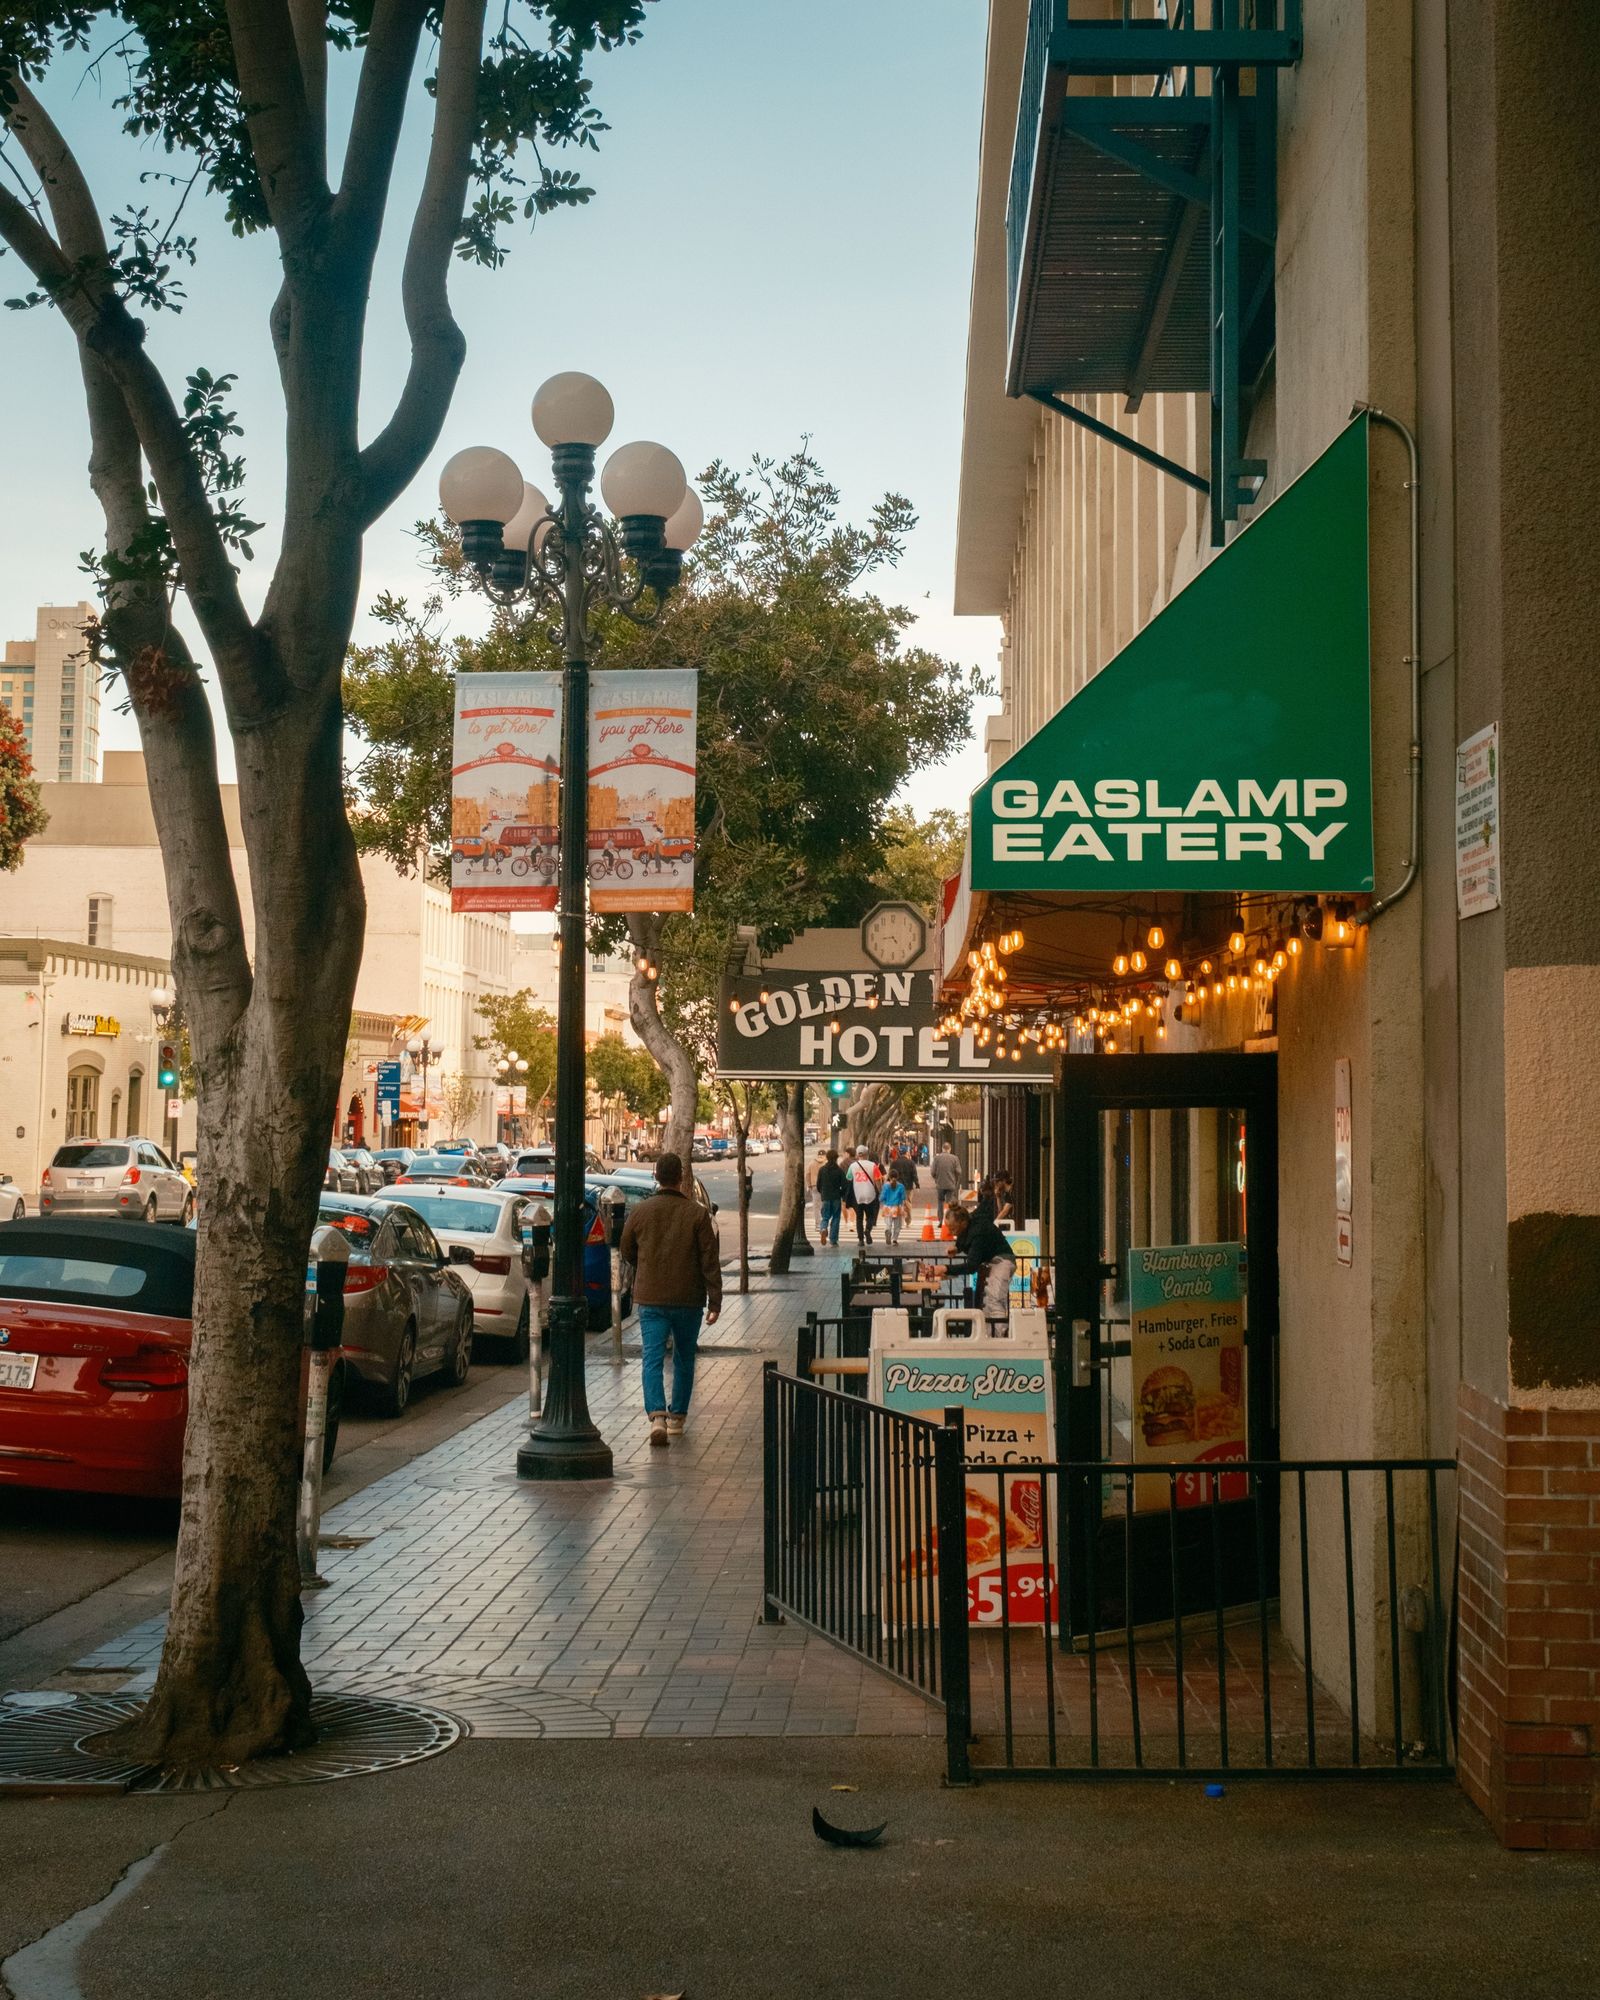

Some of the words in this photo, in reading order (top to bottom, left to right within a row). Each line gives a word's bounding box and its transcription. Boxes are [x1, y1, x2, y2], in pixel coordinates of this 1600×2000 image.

[468, 719, 482, 735] to
[484, 717, 508, 741] get
[507, 716, 548, 735] here?
[599, 724, 625, 743] you
[627, 717, 652, 743] get
[653, 717, 685, 735] here
[991, 778, 1349, 818] GASLAMP
[992, 822, 1349, 862] EATERY
[735, 972, 915, 1038] GOLDEN
[799, 1025, 991, 1068] HOTEL
[1142, 1250, 1230, 1275] Hamburger
[1161, 1275, 1213, 1300] Combo
[1138, 1317, 1208, 1334] Hamburger,
[1210, 1312, 1238, 1327] Fries
[1158, 1342, 1165, 1353] +
[1168, 1335, 1196, 1351] Soda
[1198, 1333, 1220, 1349] Can
[885, 1362, 970, 1393] Pizza
[972, 1364, 1045, 1400] Slice
[966, 1425, 1018, 1442] Pizza
[1024, 1429, 1035, 1442] +
[964, 1450, 998, 1464] oda
[1003, 1450, 1043, 1464] Can
